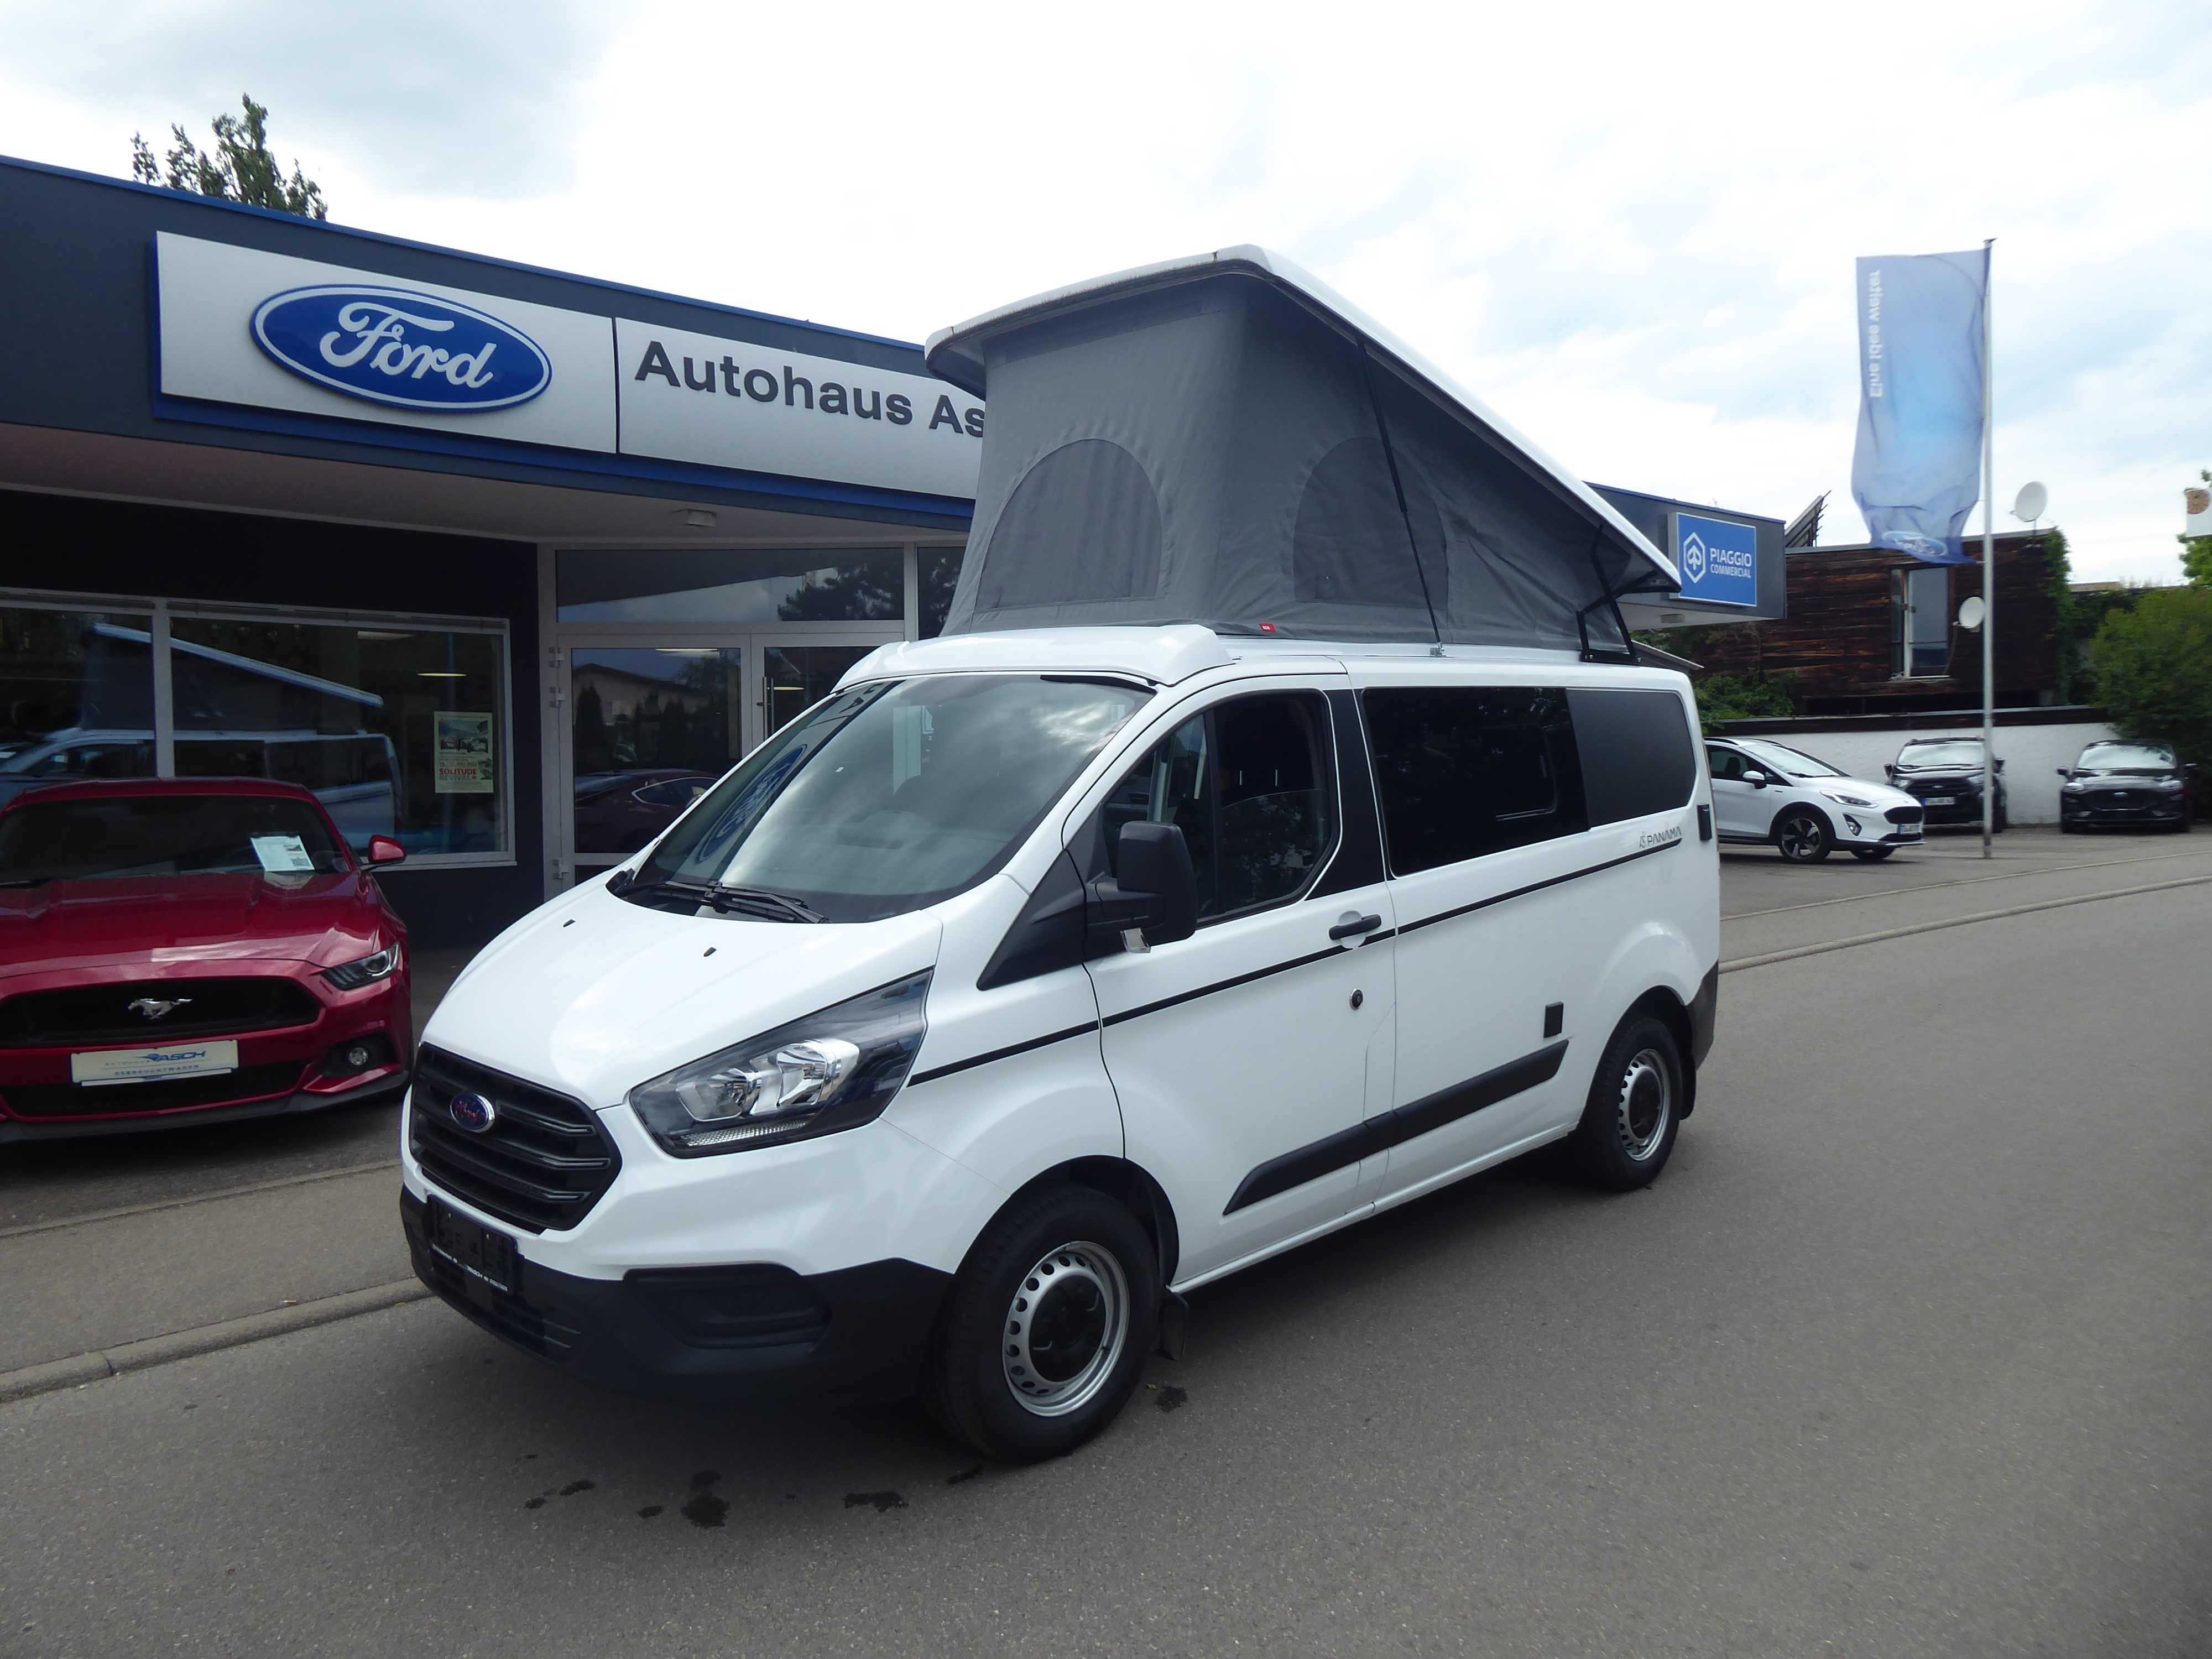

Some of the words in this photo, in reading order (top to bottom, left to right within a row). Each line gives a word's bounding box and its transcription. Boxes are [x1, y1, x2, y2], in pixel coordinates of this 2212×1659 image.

[319, 301, 498, 389] Ford
[634, 340, 914, 426] Autohaus
[928, 394, 986, 438] As
[1709, 547, 1752, 567] PIAGGIO
[1710, 564, 1751, 578] COMMERCIAL
[1647, 826, 1682, 846] PANAMA
